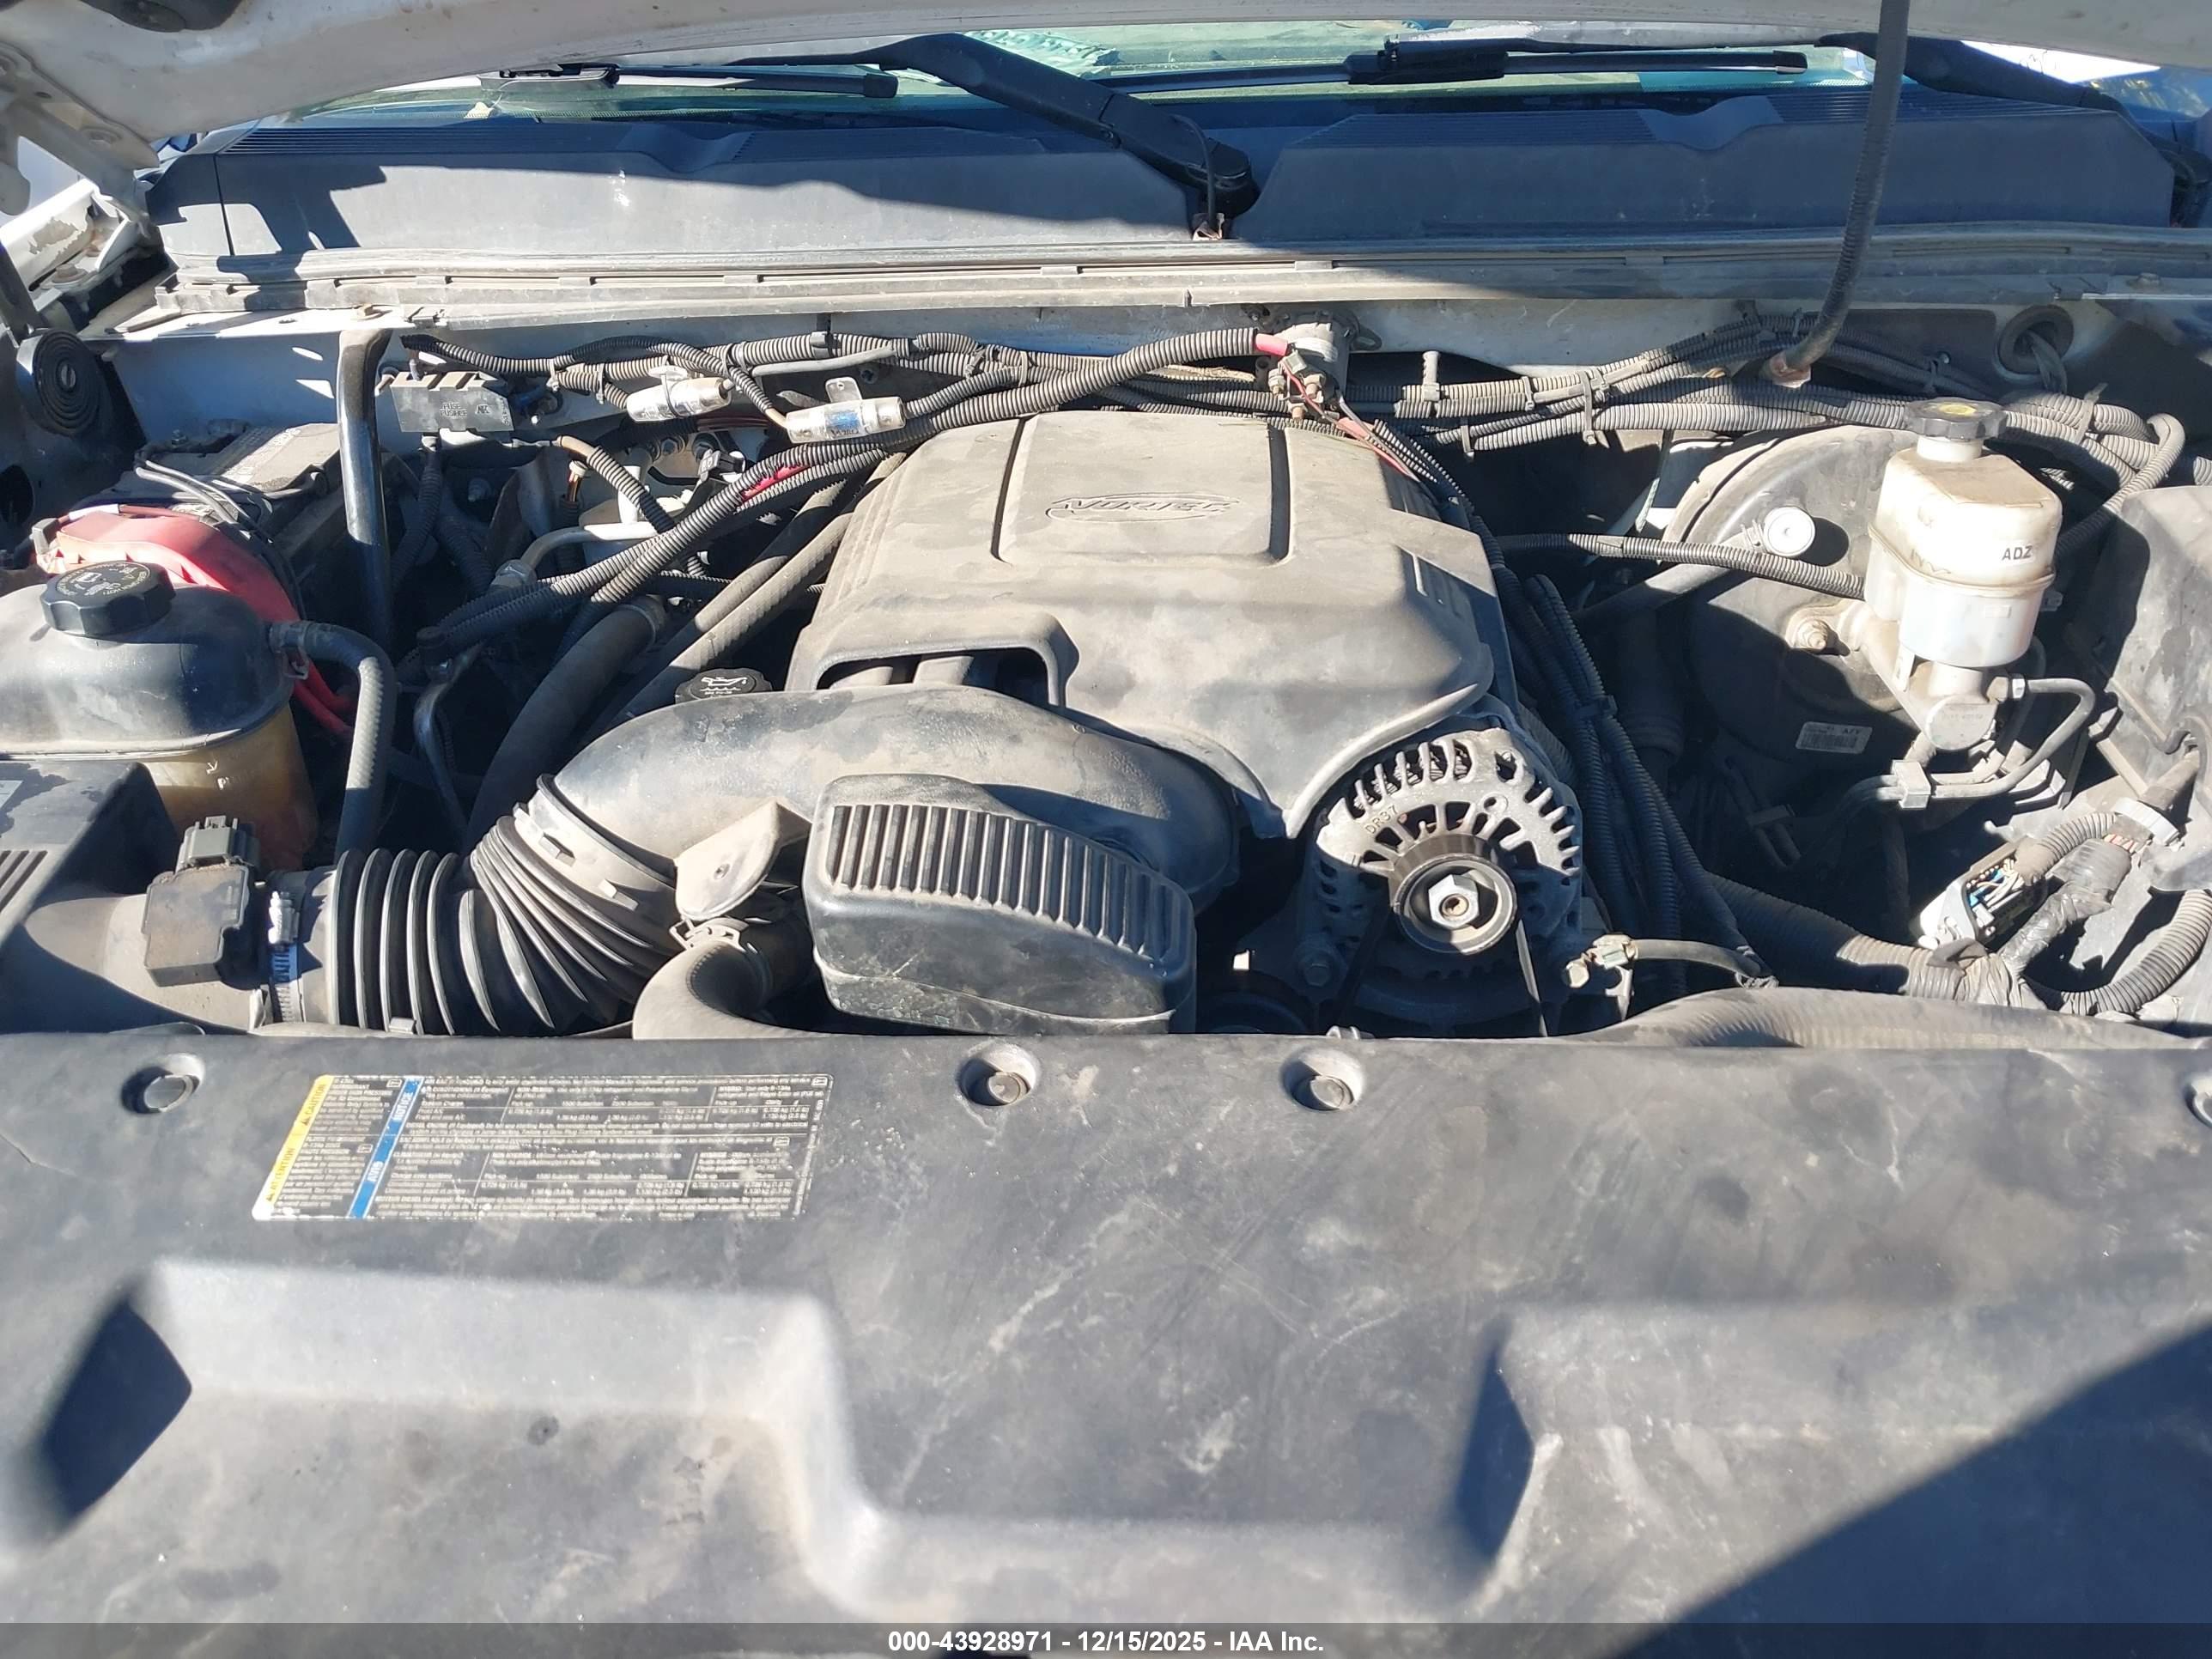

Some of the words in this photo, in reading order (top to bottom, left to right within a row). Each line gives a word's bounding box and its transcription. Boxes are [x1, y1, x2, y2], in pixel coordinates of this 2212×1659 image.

[2002, 544, 2033, 561] ADZ
[1364, 805, 1398, 834] DR37
[307, 1084, 326, 1115] CAUTION
[393, 1092, 413, 1121] NOTICE
[368, 1161, 385, 1182] AVIS
